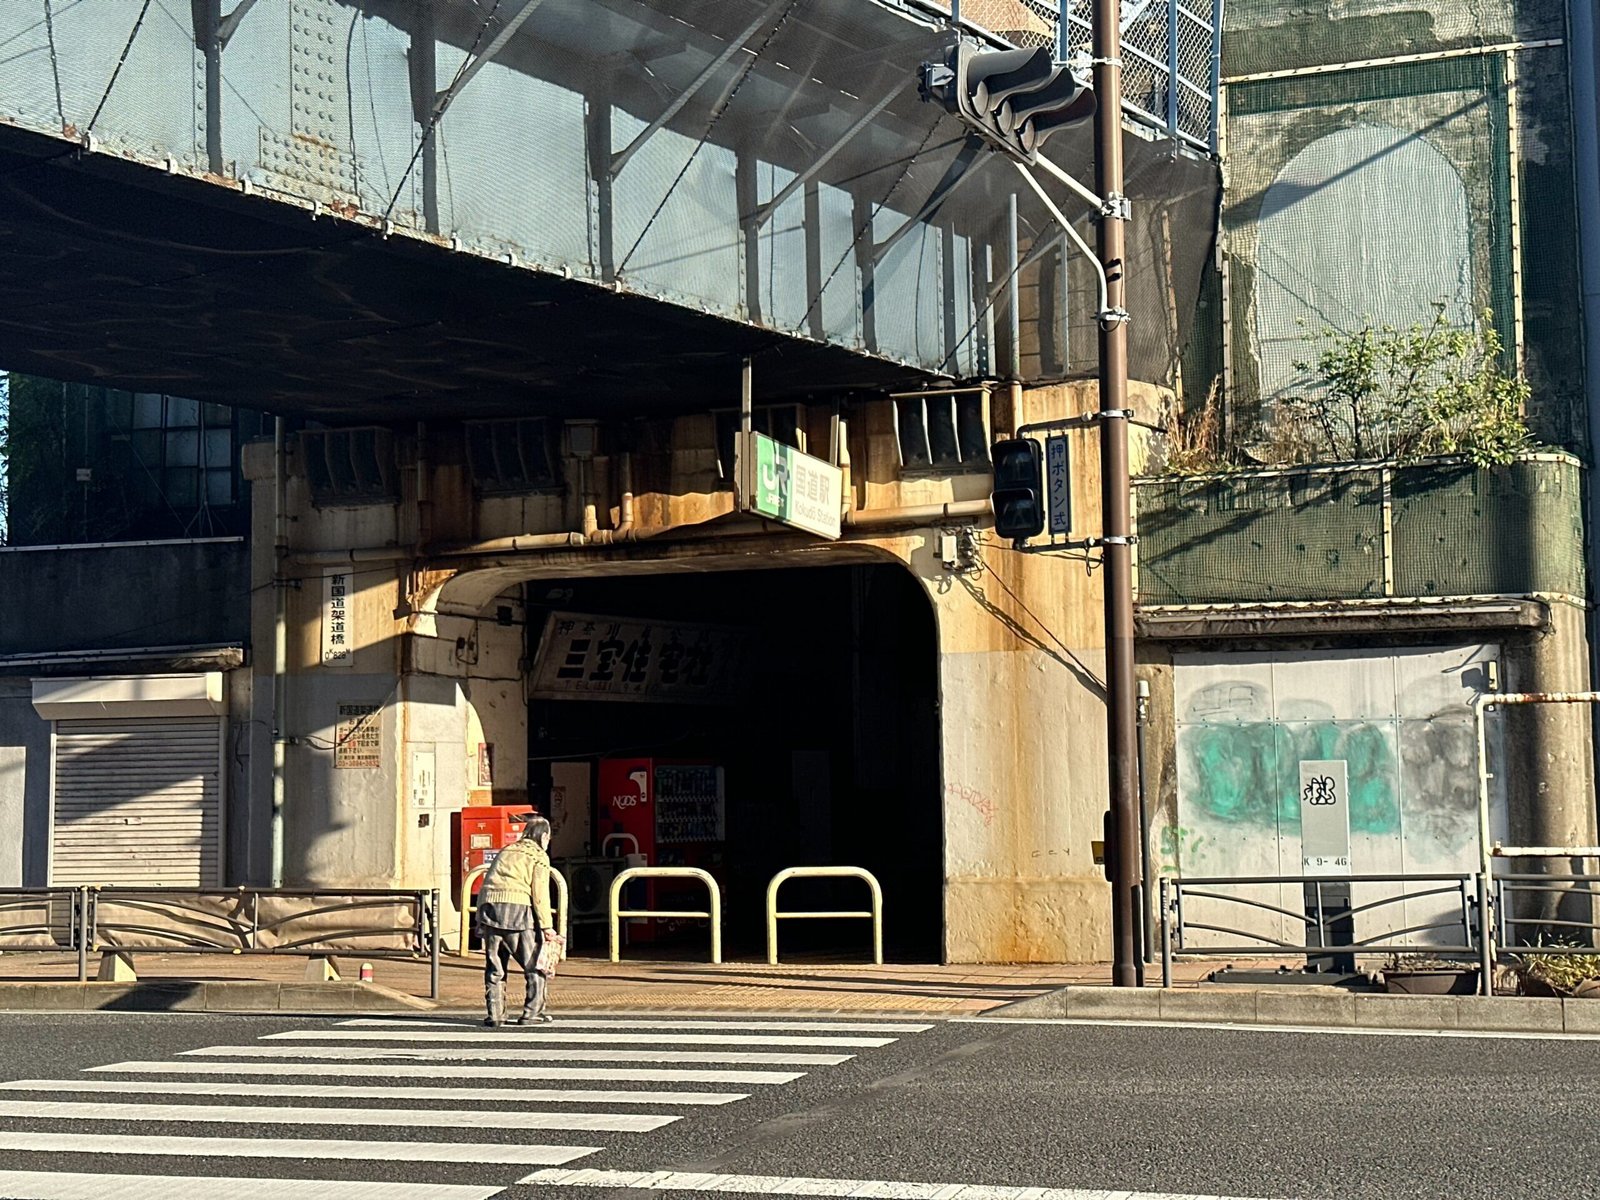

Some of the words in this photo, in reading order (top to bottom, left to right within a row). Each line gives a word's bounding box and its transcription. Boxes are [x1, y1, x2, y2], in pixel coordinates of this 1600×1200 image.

[795, 464, 830, 505] 国道駅
[1051, 444, 1066, 526] 押ボタン式
[331, 574, 345, 645] 新国道架道橋
[1303, 857, 1310, 867] K
